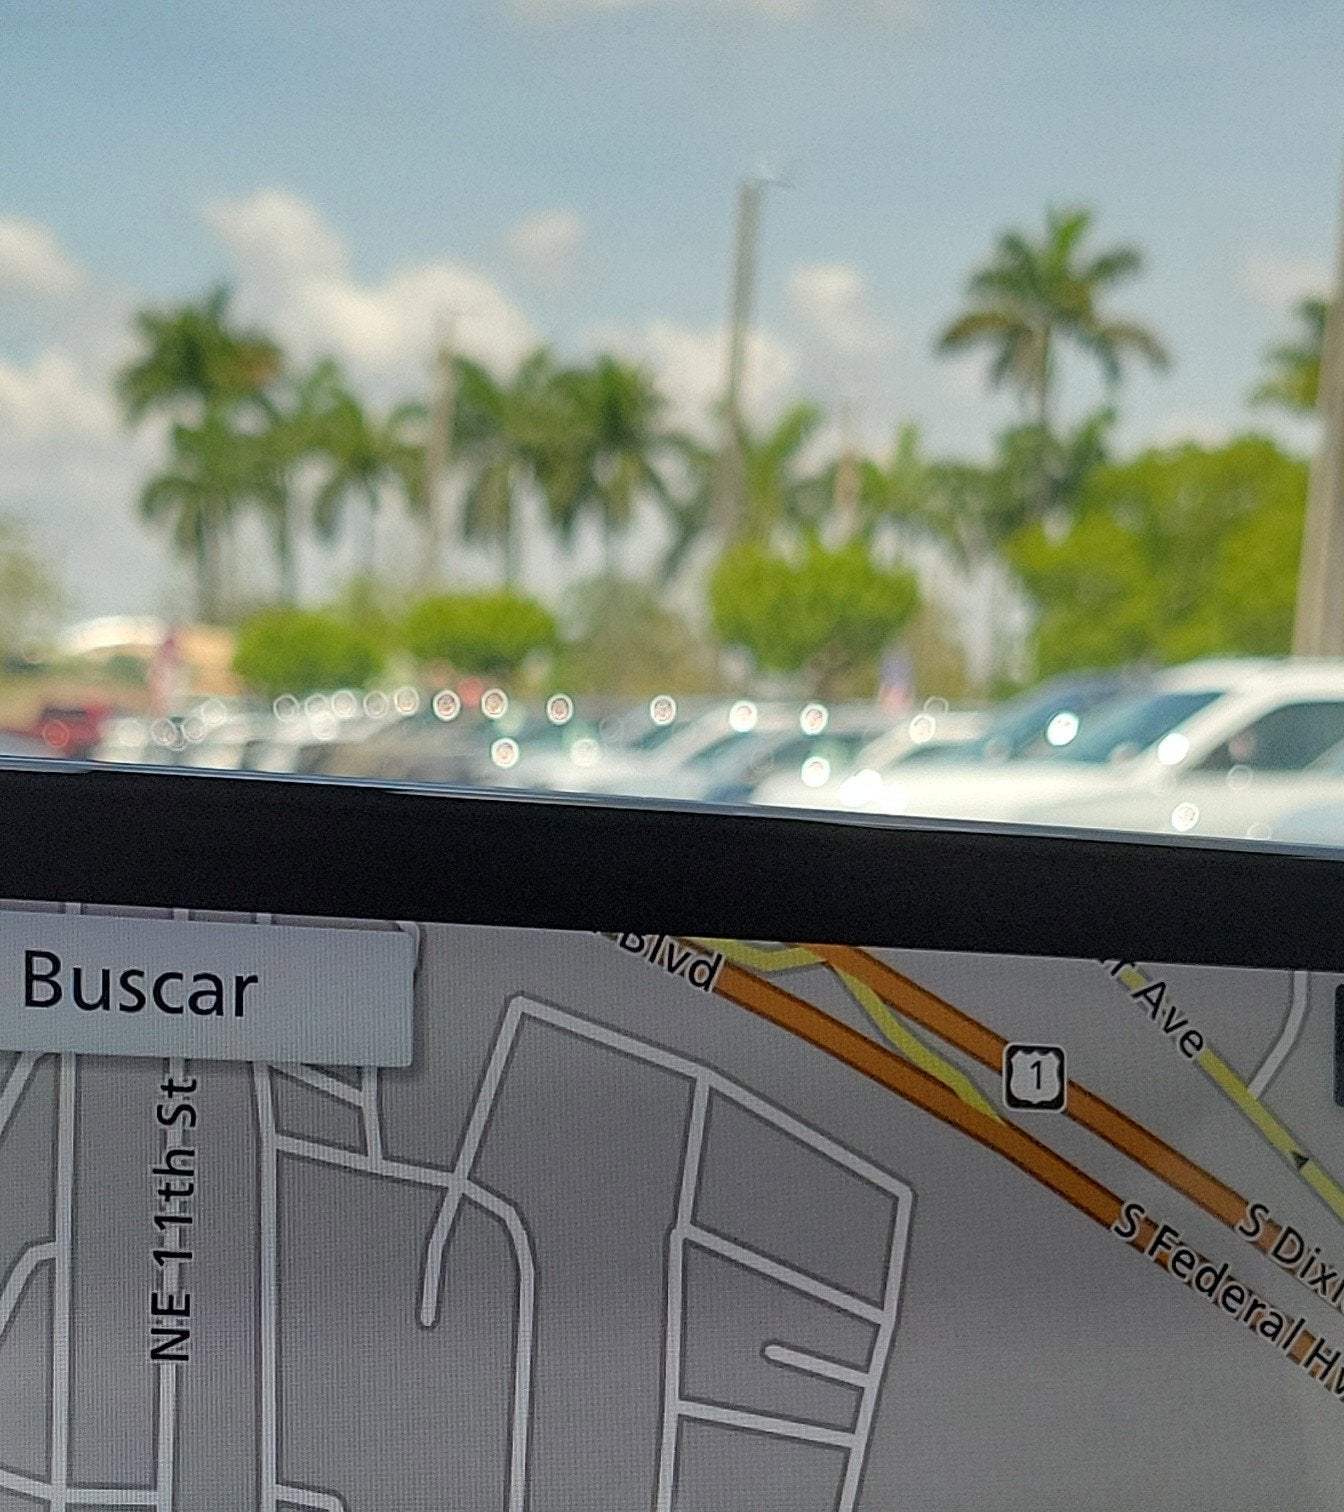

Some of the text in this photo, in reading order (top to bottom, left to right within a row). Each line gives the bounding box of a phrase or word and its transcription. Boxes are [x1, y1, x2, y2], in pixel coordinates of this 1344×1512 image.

[24, 949, 259, 1018] Buscar
[1131, 981, 1204, 1058] Ave
[1028, 1061, 1042, 1091] 1
[150, 1077, 198, 1362] NE 11th St
[1238, 1203, 1271, 1239] S
[1114, 1202, 1148, 1240] S
[1151, 1225, 1308, 1352] Federal
